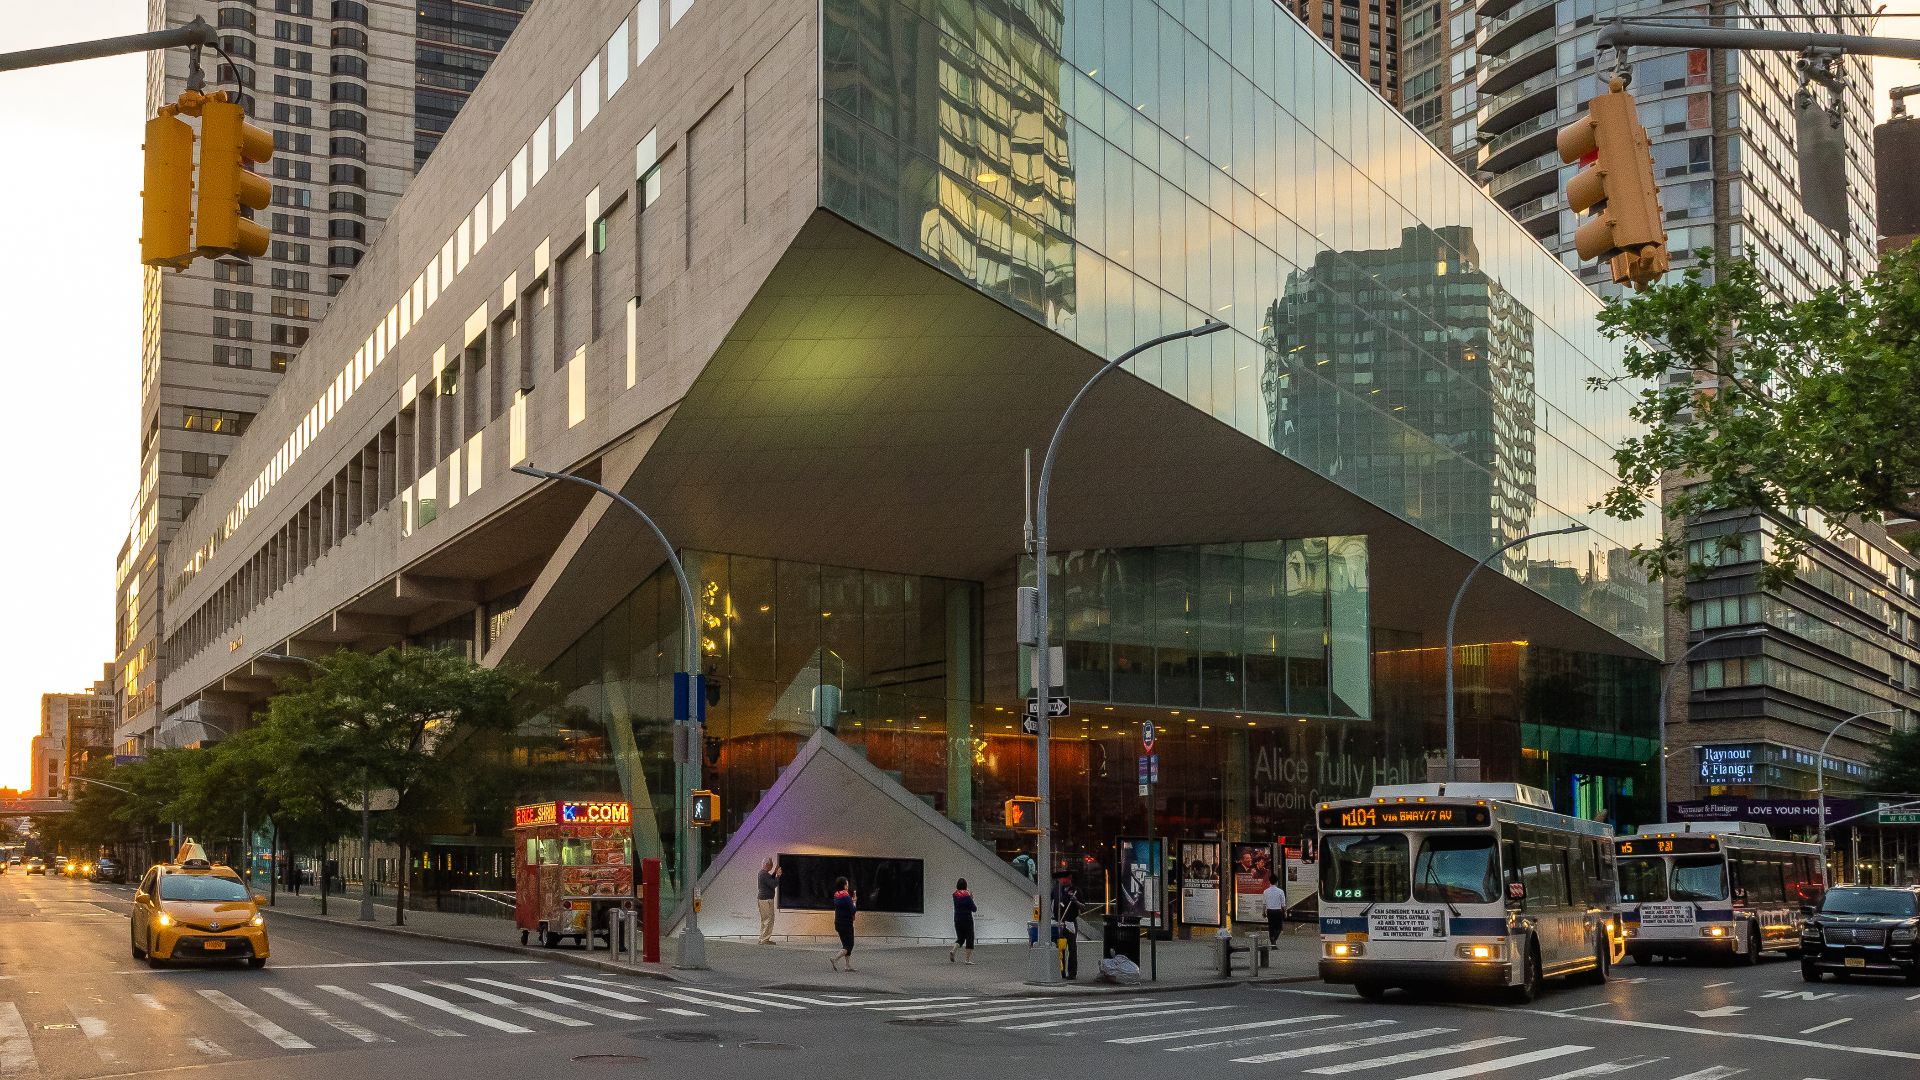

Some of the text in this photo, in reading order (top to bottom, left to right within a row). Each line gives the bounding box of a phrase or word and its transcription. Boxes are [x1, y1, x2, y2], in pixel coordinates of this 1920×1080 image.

[1705, 748, 1751, 762] Raymour
[1254, 745, 1409, 795] Alice Tully Hall
[1701, 761, 1709, 776] &
[1256, 785, 1306, 810] Lincoln
[1342, 808, 1376, 826] M104
[1399, 811, 1436, 821] BWAY/7
[1439, 810, 1452, 820] AV
[1748, 806, 1772, 815] LOVE
[1774, 806, 1800, 815] YOUR
[1621, 842, 1633, 853] M5
